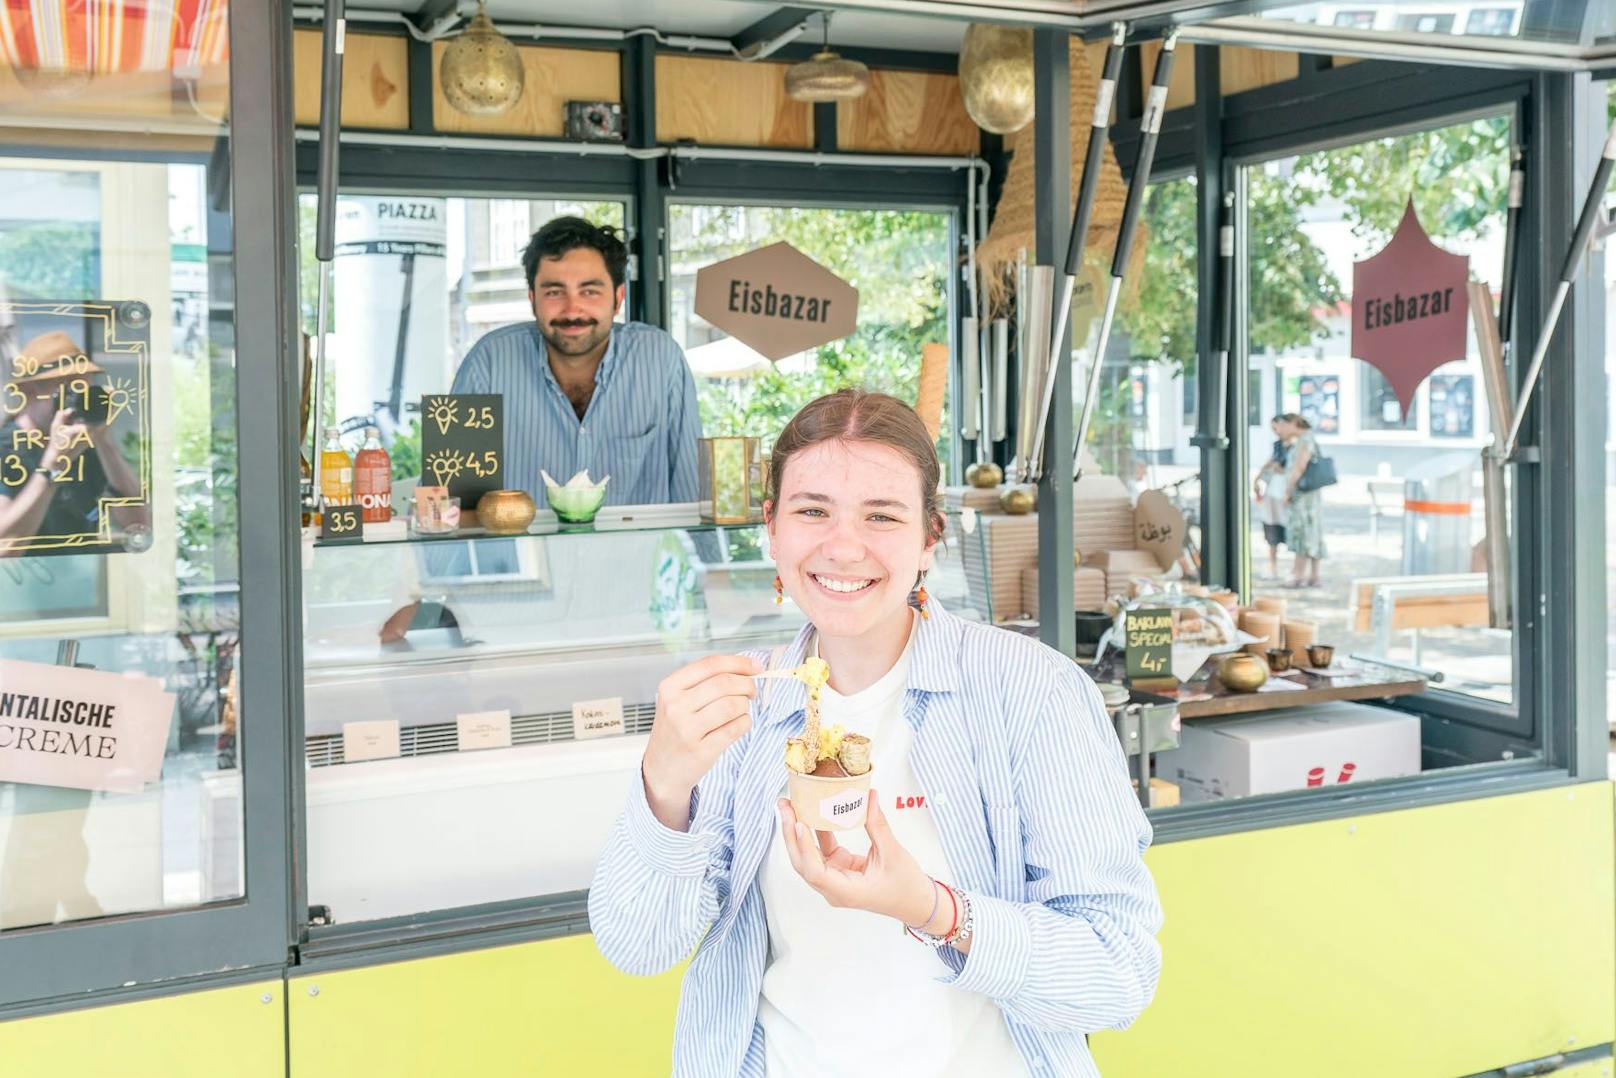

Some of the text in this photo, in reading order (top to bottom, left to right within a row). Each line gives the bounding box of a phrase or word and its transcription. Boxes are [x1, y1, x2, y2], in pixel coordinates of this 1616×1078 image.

[378, 203, 438, 219] PIAZZA
[728, 279, 832, 323] Eisbazar
[1364, 287, 1453, 331] Eisbazar
[463, 407, 495, 430] 2,5
[465, 451, 499, 479] 4,5
[330, 511, 357, 533] 3,5
[0, 724, 118, 760] CREME
[896, 796, 928, 809] LOV
